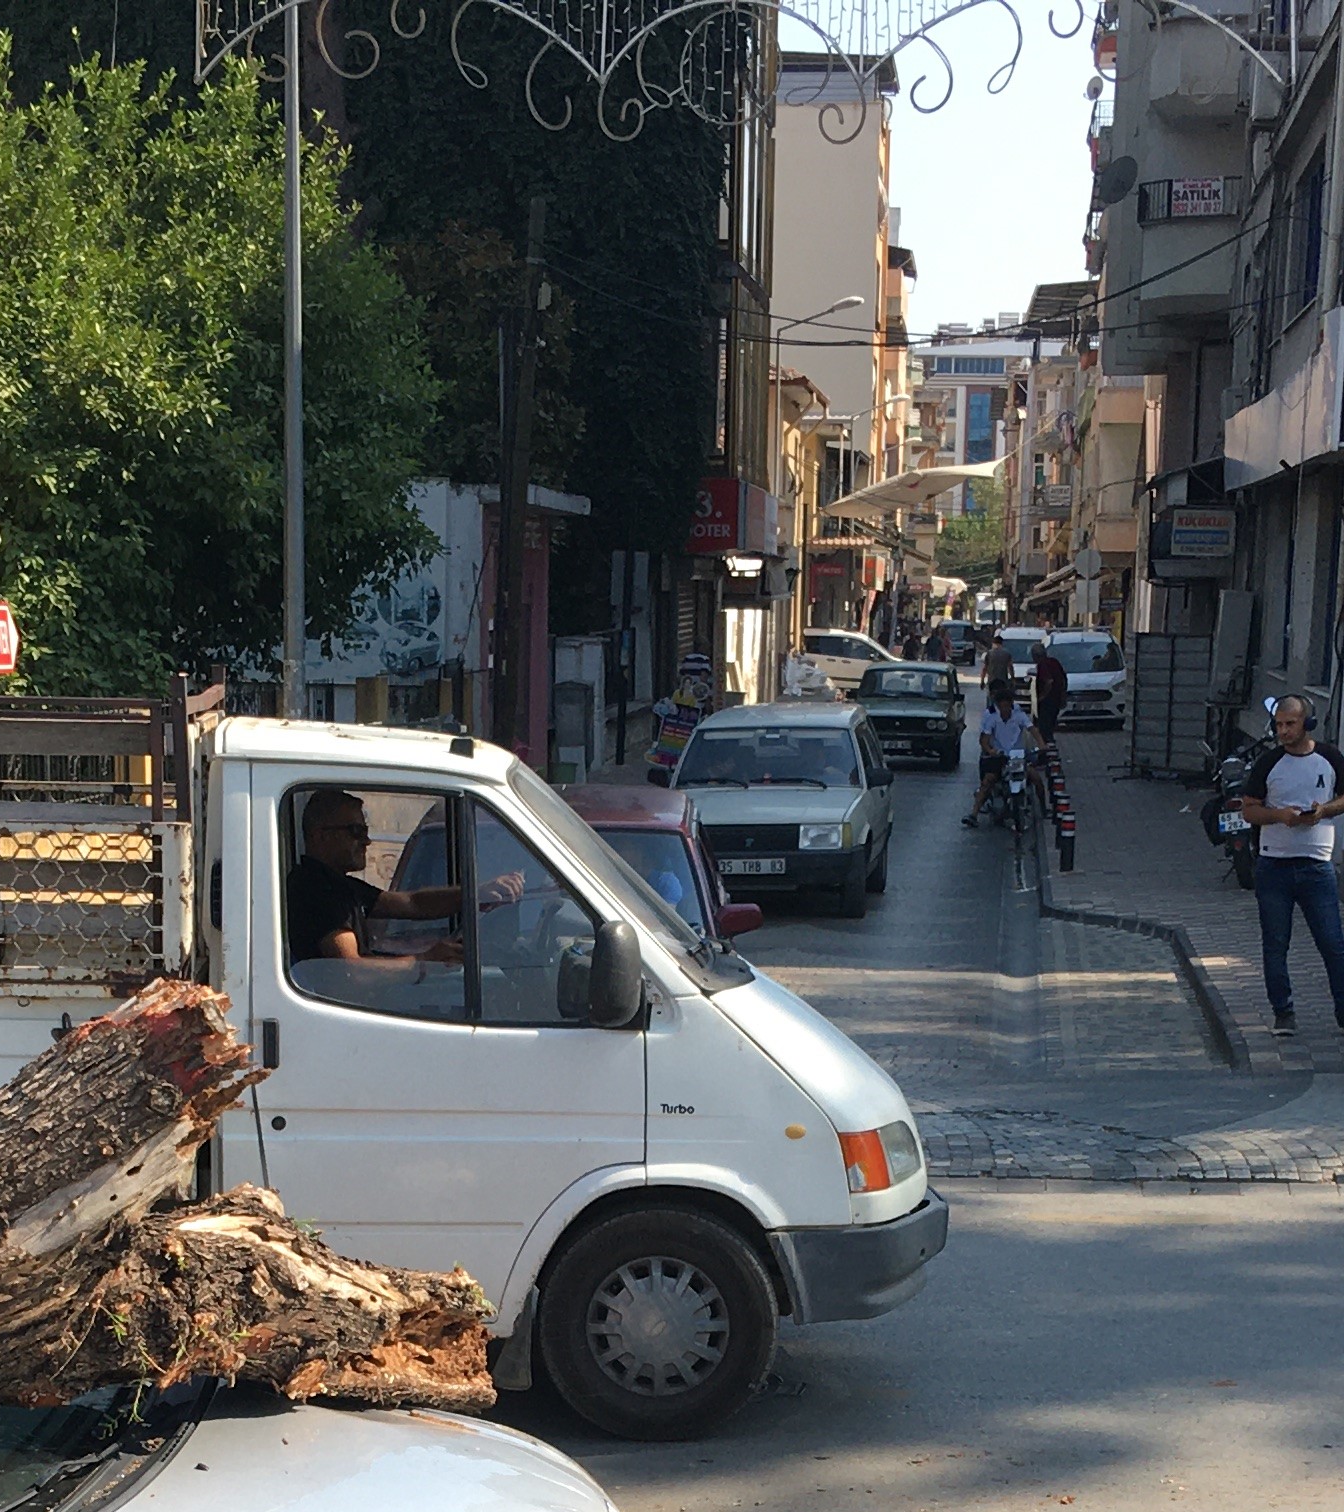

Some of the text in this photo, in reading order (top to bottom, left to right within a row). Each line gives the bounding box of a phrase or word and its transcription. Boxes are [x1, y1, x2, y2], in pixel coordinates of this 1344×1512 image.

[1172, 189, 1221, 201] SATILIK
[695, 491, 723, 518] 3.
[689, 523, 731, 537] OTER
[720, 861, 733, 872] 35
[660, 1103, 695, 1115] Turbo
